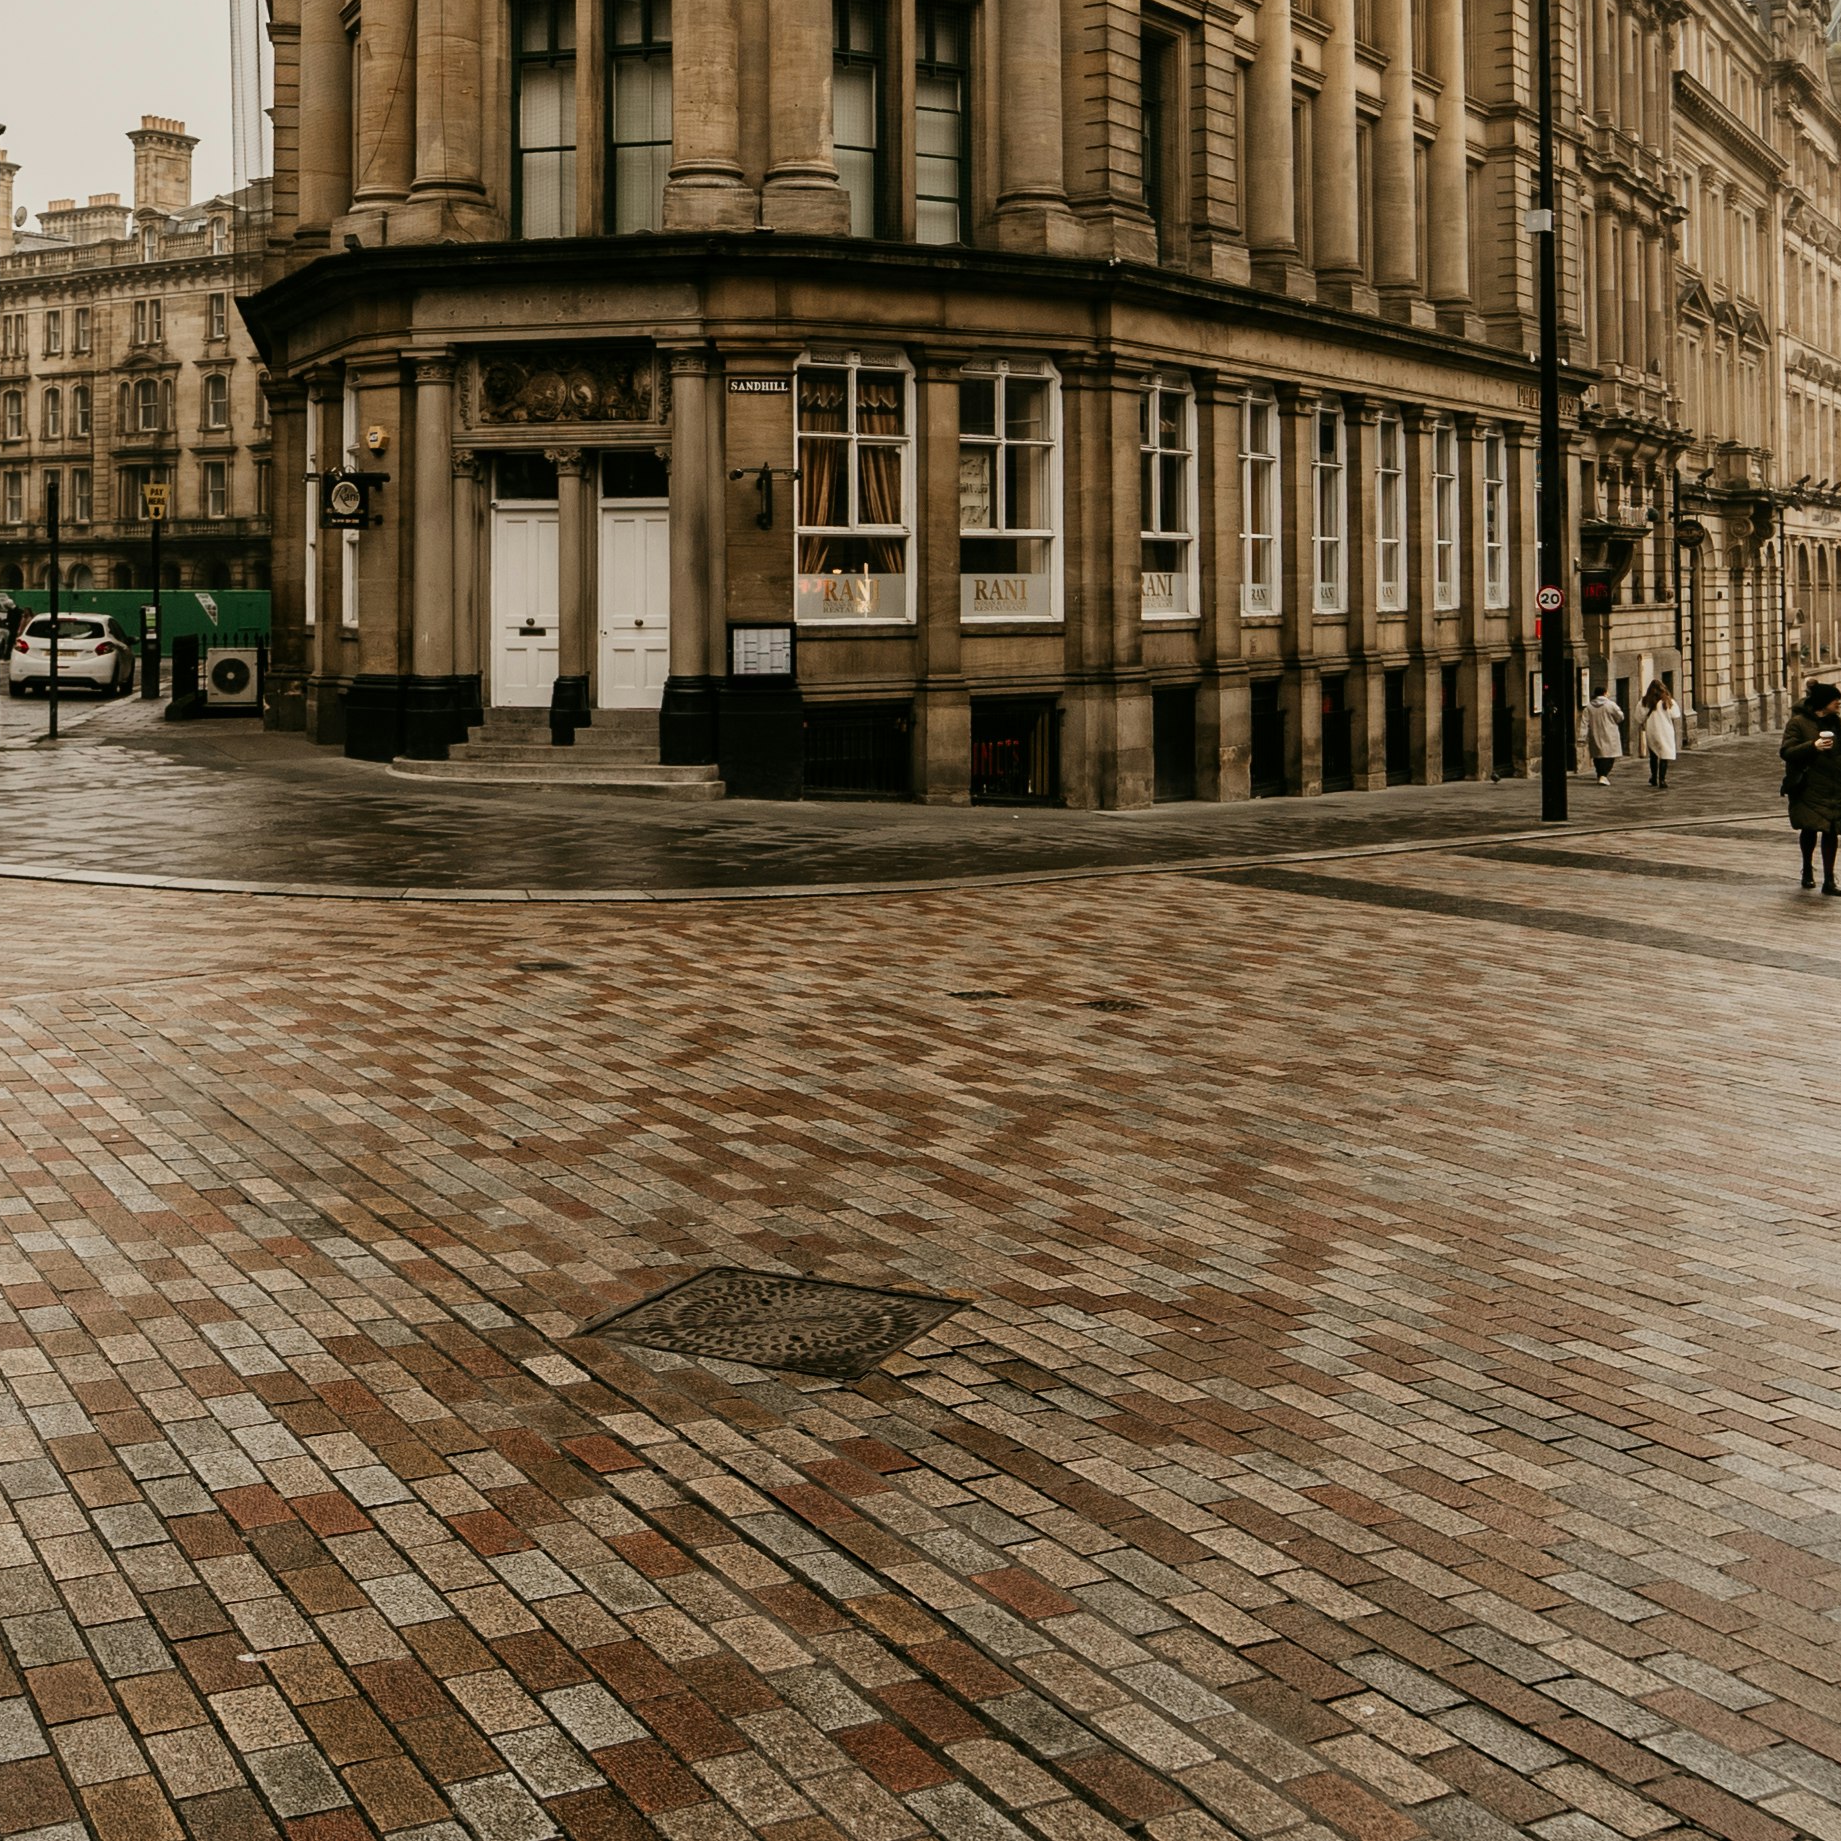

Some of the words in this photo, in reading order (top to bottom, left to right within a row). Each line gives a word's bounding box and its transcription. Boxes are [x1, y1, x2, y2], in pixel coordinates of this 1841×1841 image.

[730, 381, 789, 391] SANDHILL
[150, 488, 164, 496] PAY
[823, 578, 879, 601] RANI
[974, 579, 1027, 600] RANI
[1540, 593, 1560, 604] 20
